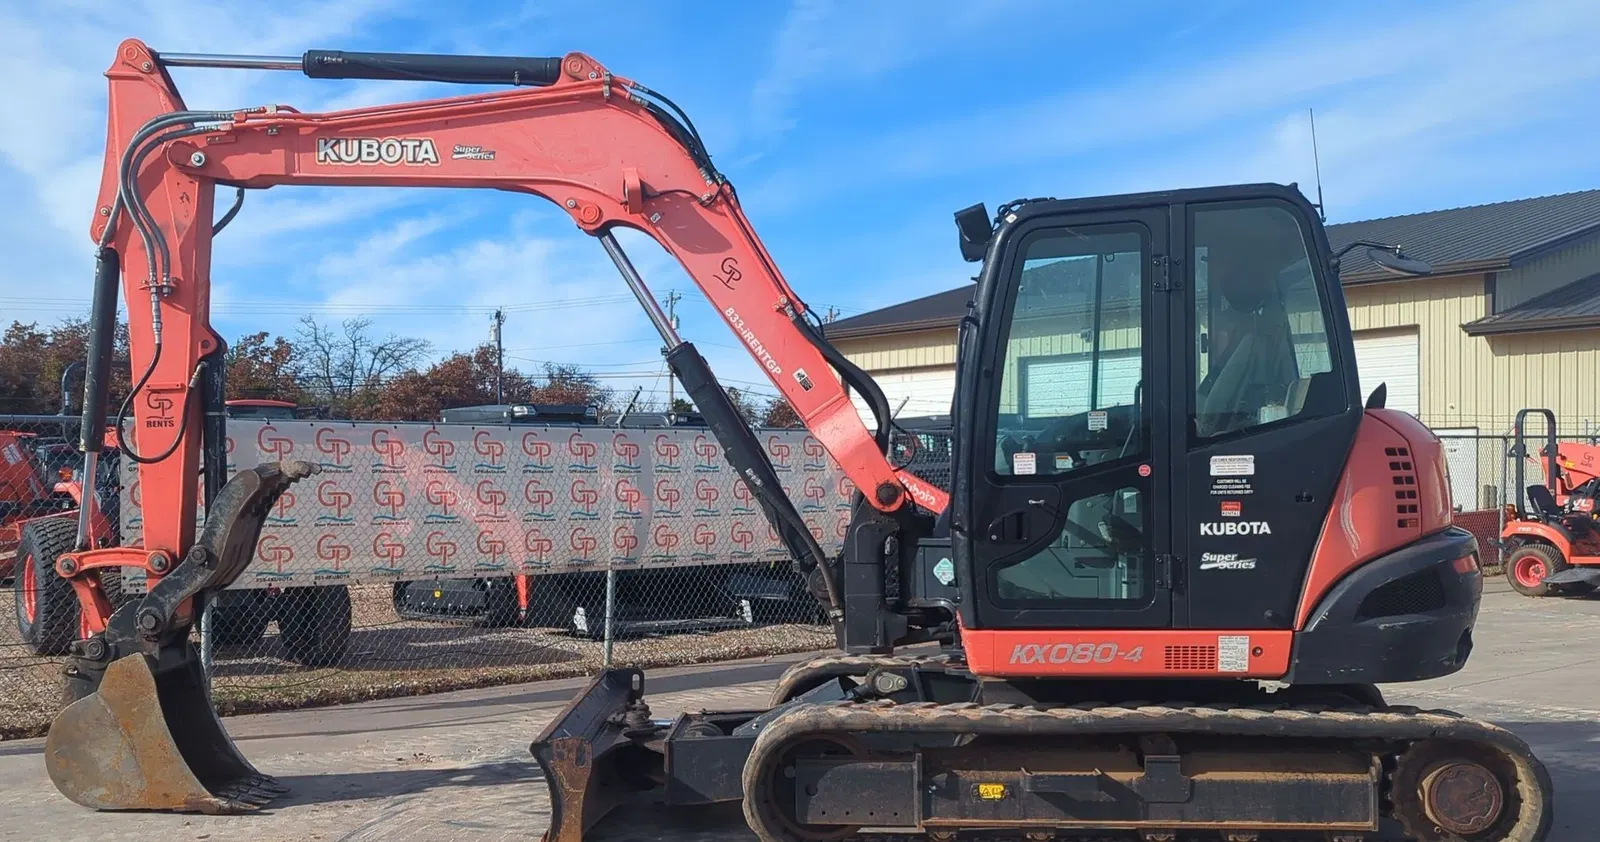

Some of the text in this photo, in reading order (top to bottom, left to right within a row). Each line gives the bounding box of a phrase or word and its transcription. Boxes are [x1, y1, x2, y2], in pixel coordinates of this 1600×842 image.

[316, 138, 439, 164] KUBOTA
[453, 144, 480, 153] Super
[720, 257, 742, 283] GP
[725, 307, 782, 375] 833-iRENTGP
[147, 391, 174, 416] GP
[257, 425, 294, 460] GP
[315, 428, 351, 464] GP
[371, 429, 404, 465] GP
[423, 430, 455, 465] GP
[474, 431, 504, 465] GP
[522, 432, 551, 465] GP
[568, 433, 596, 465] GP
[613, 433, 639, 465] GP
[655, 435, 680, 465] GP
[694, 435, 718, 465] GP
[768, 436, 790, 464] GP
[803, 436, 824, 464] GP
[318, 480, 352, 517] GP
[373, 480, 405, 516] GP
[425, 480, 457, 515] GP
[476, 479, 506, 514] GP
[525, 480, 553, 513] GP
[571, 480, 598, 512] GP
[615, 479, 640, 511] GP
[656, 479, 680, 510] GP
[695, 479, 719, 509] GP
[570, 527, 597, 559] GP
[613, 526, 638, 557] GP
[654, 524, 678, 555] GP
[694, 523, 716, 553] GP
[731, 521, 754, 551] GP
[1200, 522, 1271, 535] KUBOTA
[257, 535, 294, 573] GP
[316, 534, 351, 570] GP
[373, 532, 405, 568] GP
[426, 531, 457, 566] GP
[476, 530, 505, 563] GP
[525, 529, 552, 561] GP
[1202, 552, 1238, 562] Super
[1219, 559, 1256, 569] Series
[1009, 643, 1143, 664] KX080-4
